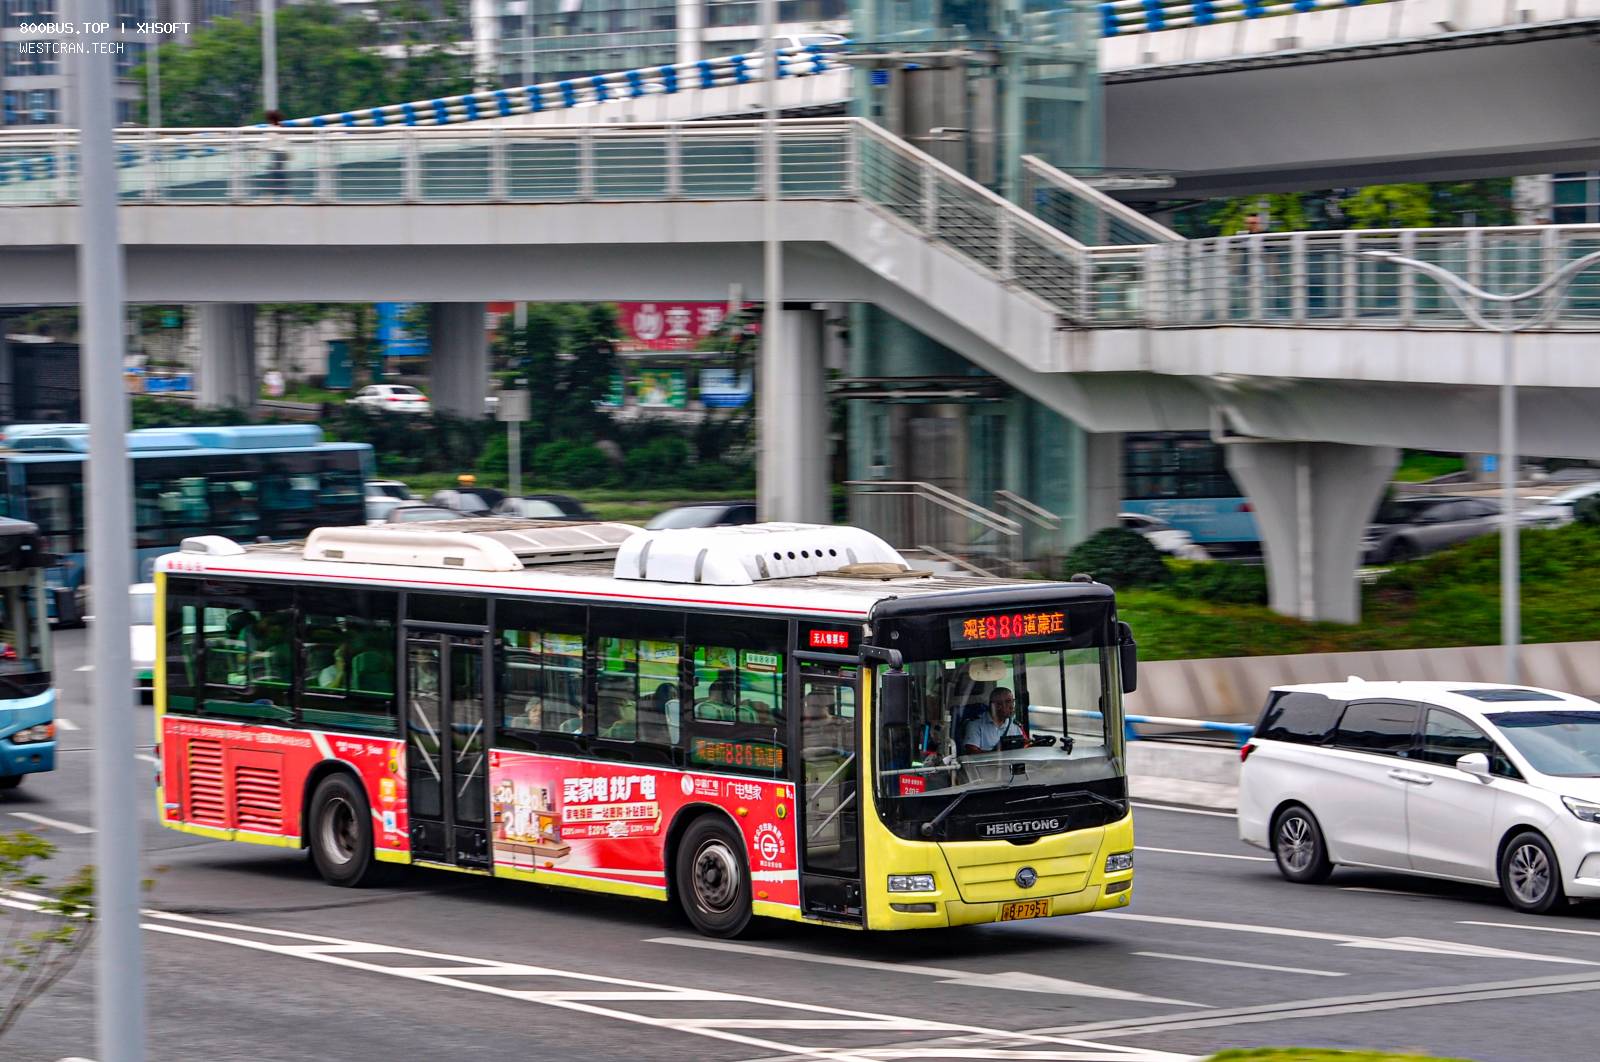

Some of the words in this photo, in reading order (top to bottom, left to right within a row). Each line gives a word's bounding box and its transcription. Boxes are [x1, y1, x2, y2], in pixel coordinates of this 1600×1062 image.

[985, 613, 1023, 640] 886
[563, 777, 609, 803] 买家电
[610, 774, 656, 801] 找广电
[986, 818, 1059, 835] HENGTONG
